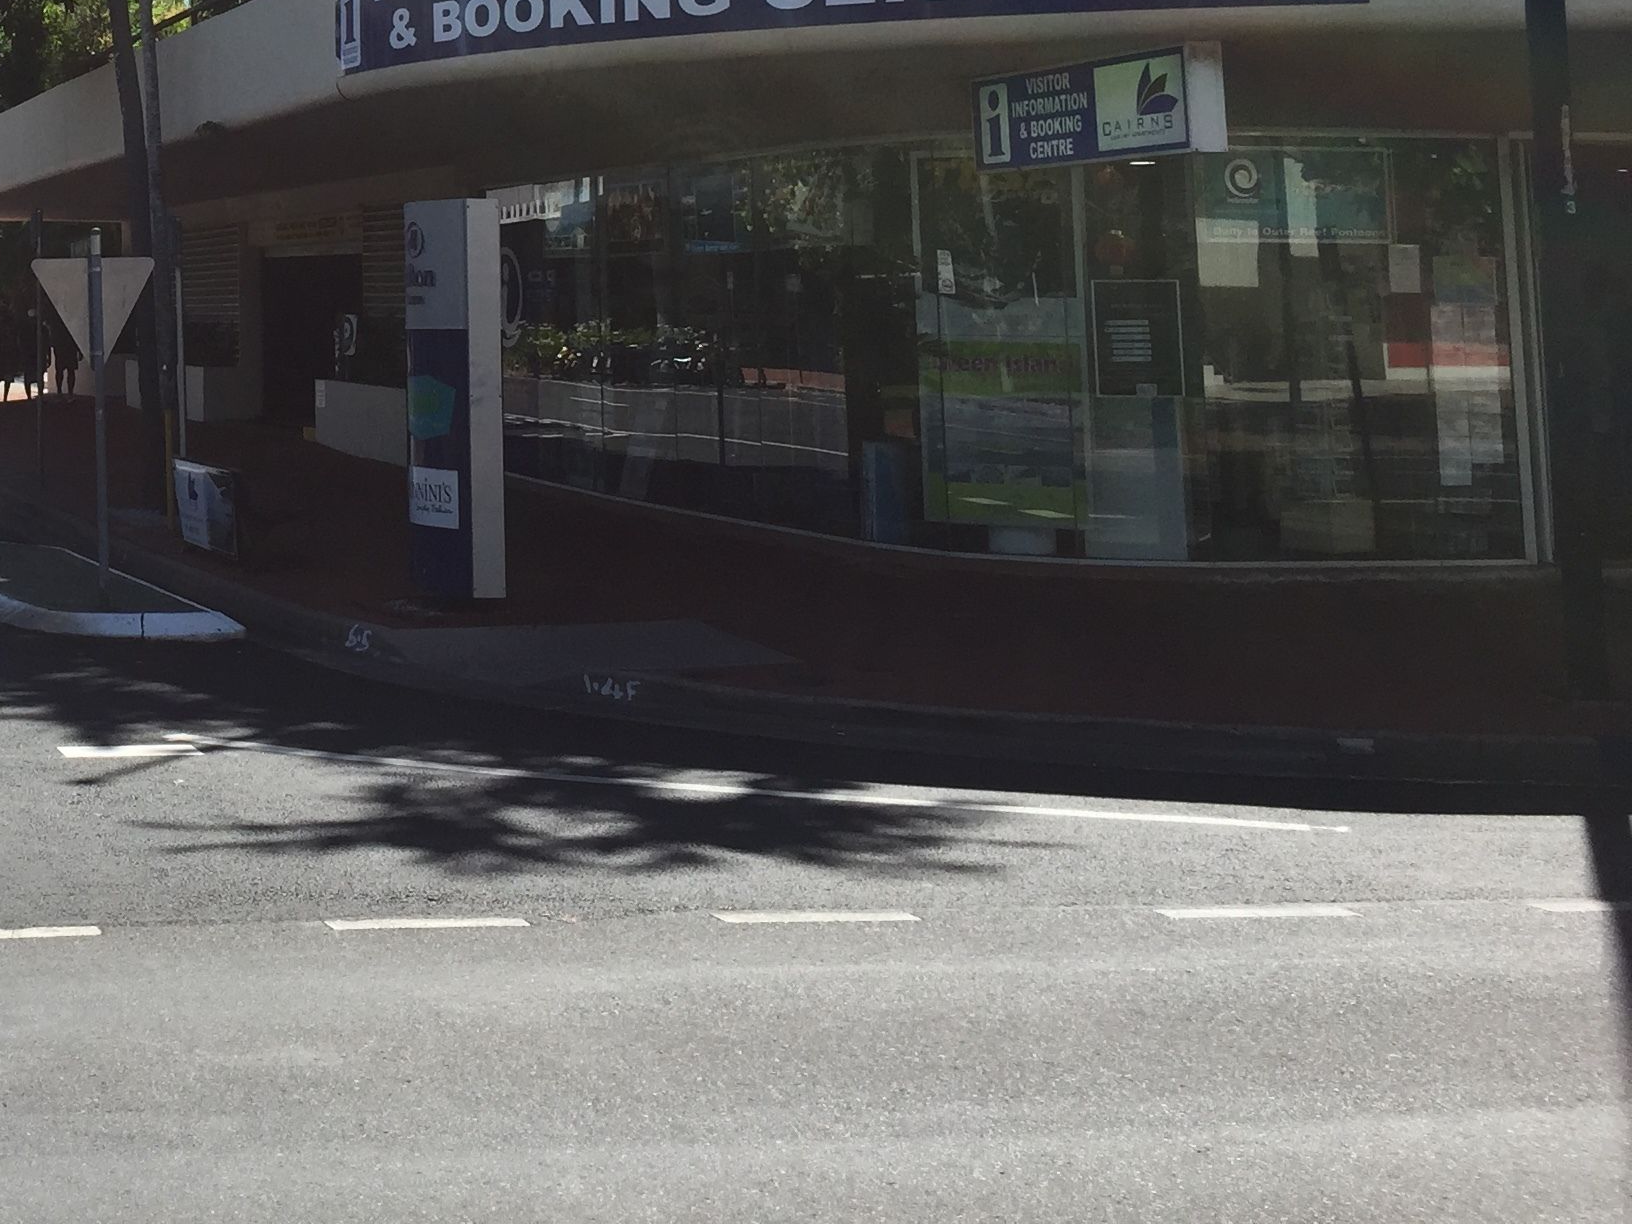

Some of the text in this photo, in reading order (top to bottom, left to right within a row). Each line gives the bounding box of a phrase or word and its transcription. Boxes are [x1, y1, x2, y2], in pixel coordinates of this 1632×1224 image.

[389, 8, 417, 50] &
[1025, 72, 1071, 95] VISITOR
[1011, 92, 1088, 118] INFORMATION
[1019, 115, 1082, 139] & BOOKING
[1102, 114, 1174, 137] CAIRNS
[1029, 138, 1074, 160] CENTRE
